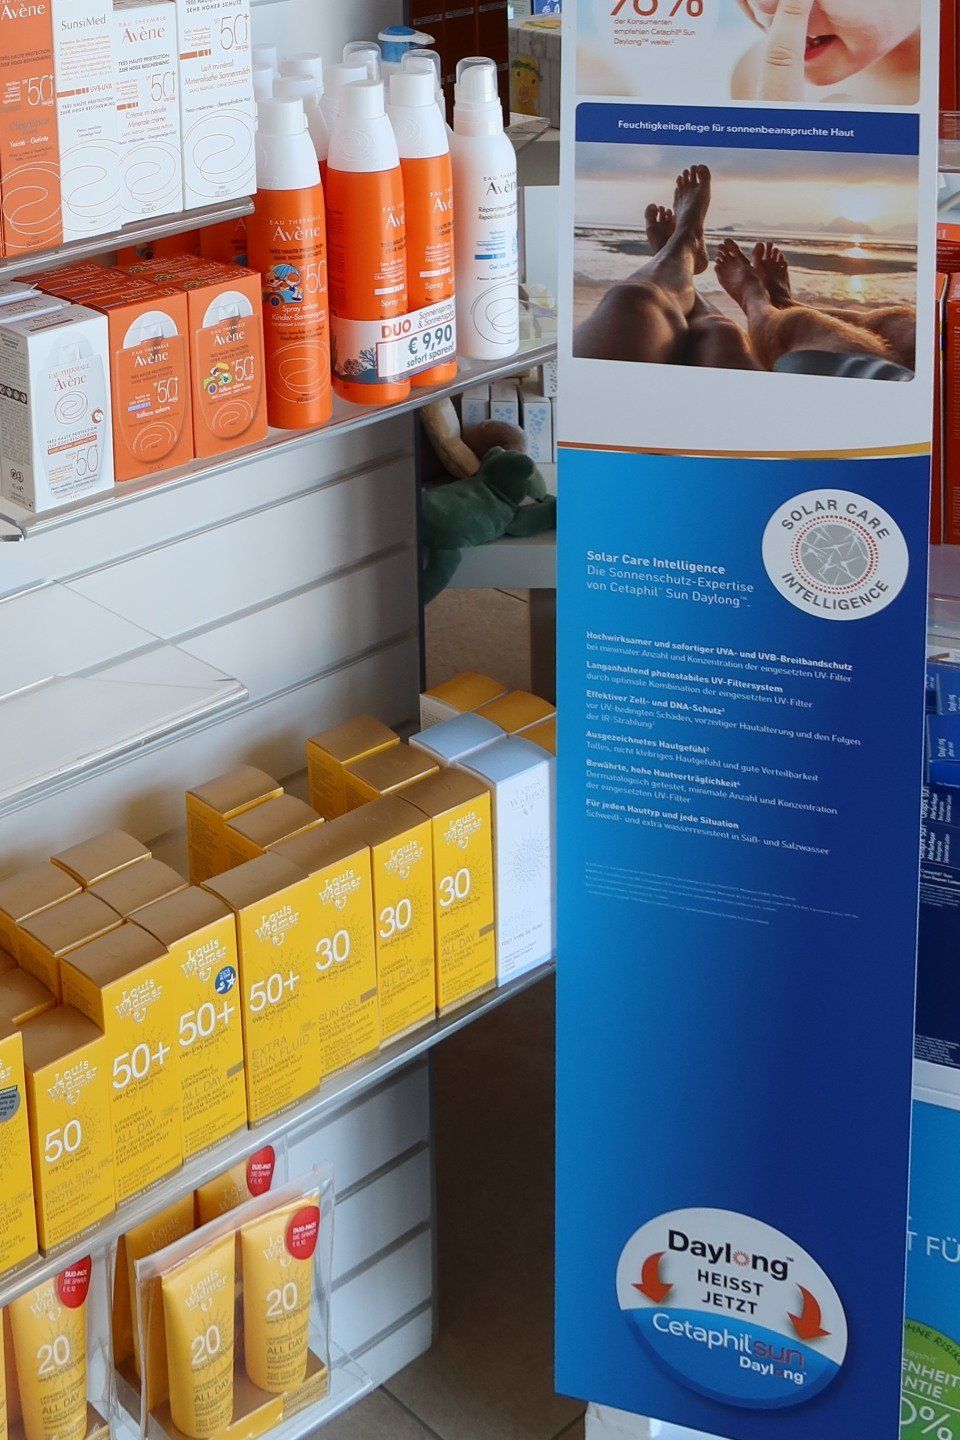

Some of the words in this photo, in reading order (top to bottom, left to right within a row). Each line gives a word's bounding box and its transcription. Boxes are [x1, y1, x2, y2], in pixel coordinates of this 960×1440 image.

[61, 14, 106, 31] SunsiMed
[618, 120, 710, 132] Feuchtigkeitspflege
[712, 123, 725, 132] für
[727, 125, 828, 136] sonnenbeanspruchte
[830, 128, 854, 137] Haut
[381, 318, 412, 339] DUO
[422, 324, 453, 350] 9,90
[406, 353, 427, 368] sofort
[780, 499, 838, 531] SOLAR
[845, 502, 890, 540] CARE
[587, 550, 619, 563] Solar
[622, 554, 650, 566] Care
[653, 558, 725, 574] Intelligence
[587, 565, 606, 575] Die
[609, 568, 754, 593] Sonnenschutz-Expertise
[587, 581, 607, 590] von
[666, 588, 688, 600] Sun
[780, 570, 889, 611] INTELLIGENCE
[586, 631, 652, 646] Hochwirksamer
[672, 643, 714, 654] sofortiger
[716, 647, 738, 656] UVA-
[740, 651, 756, 659] und
[758, 652, 853, 672] UVB-Breitbandschutz
[586, 661, 649, 676] Langanhaltend
[651, 669, 709, 684] photostabiles
[711, 677, 783, 693] UV-Filtersystem
[586, 798, 600, 807] Für
[602, 802, 625, 812] jeden
[628, 804, 660, 816] Hauttyp
[662, 810, 678, 820] und
[680, 813, 698, 823] jede
[700, 816, 739, 829] Situation
[438, 867, 471, 908] 30
[379, 897, 412, 939] 30
[315, 928, 351, 972] 30
[249, 970, 300, 1012] 50+
[178, 1001, 235, 1047] 50+
[112, 1041, 170, 1090] 50+
[44, 1119, 82, 1163] 50
[266, 1282, 298, 1317] 20
[697, 1268, 764, 1296] HEISST
[702, 1291, 758, 1315] JETZT
[37, 1335, 71, 1375] 20
[191, 1324, 220, 1365] 20
